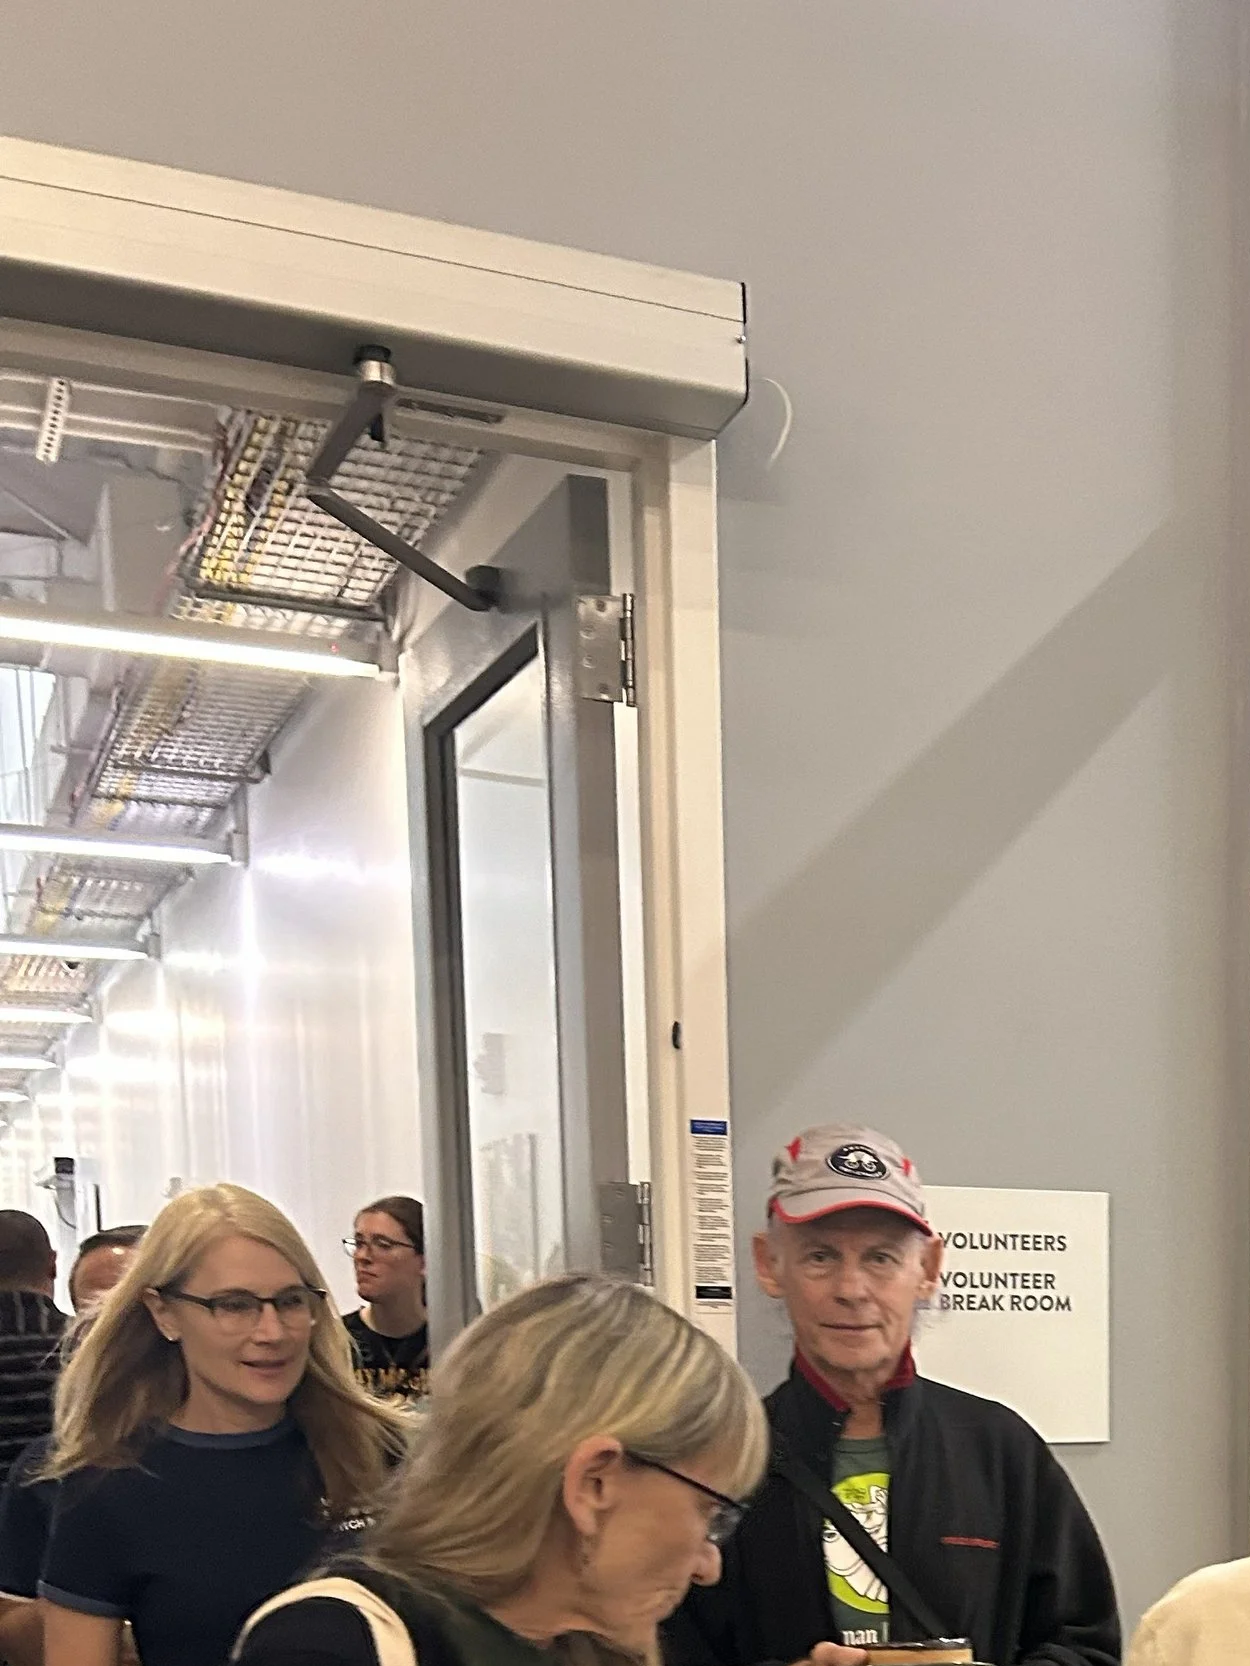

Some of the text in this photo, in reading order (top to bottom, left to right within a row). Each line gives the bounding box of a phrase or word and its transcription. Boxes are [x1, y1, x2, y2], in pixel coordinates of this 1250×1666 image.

[938, 1231, 1068, 1251] VOLUNTEERS
[940, 1271, 1056, 1290] VOLUNTEER
[940, 1294, 1072, 1311] BREAK ROOM
